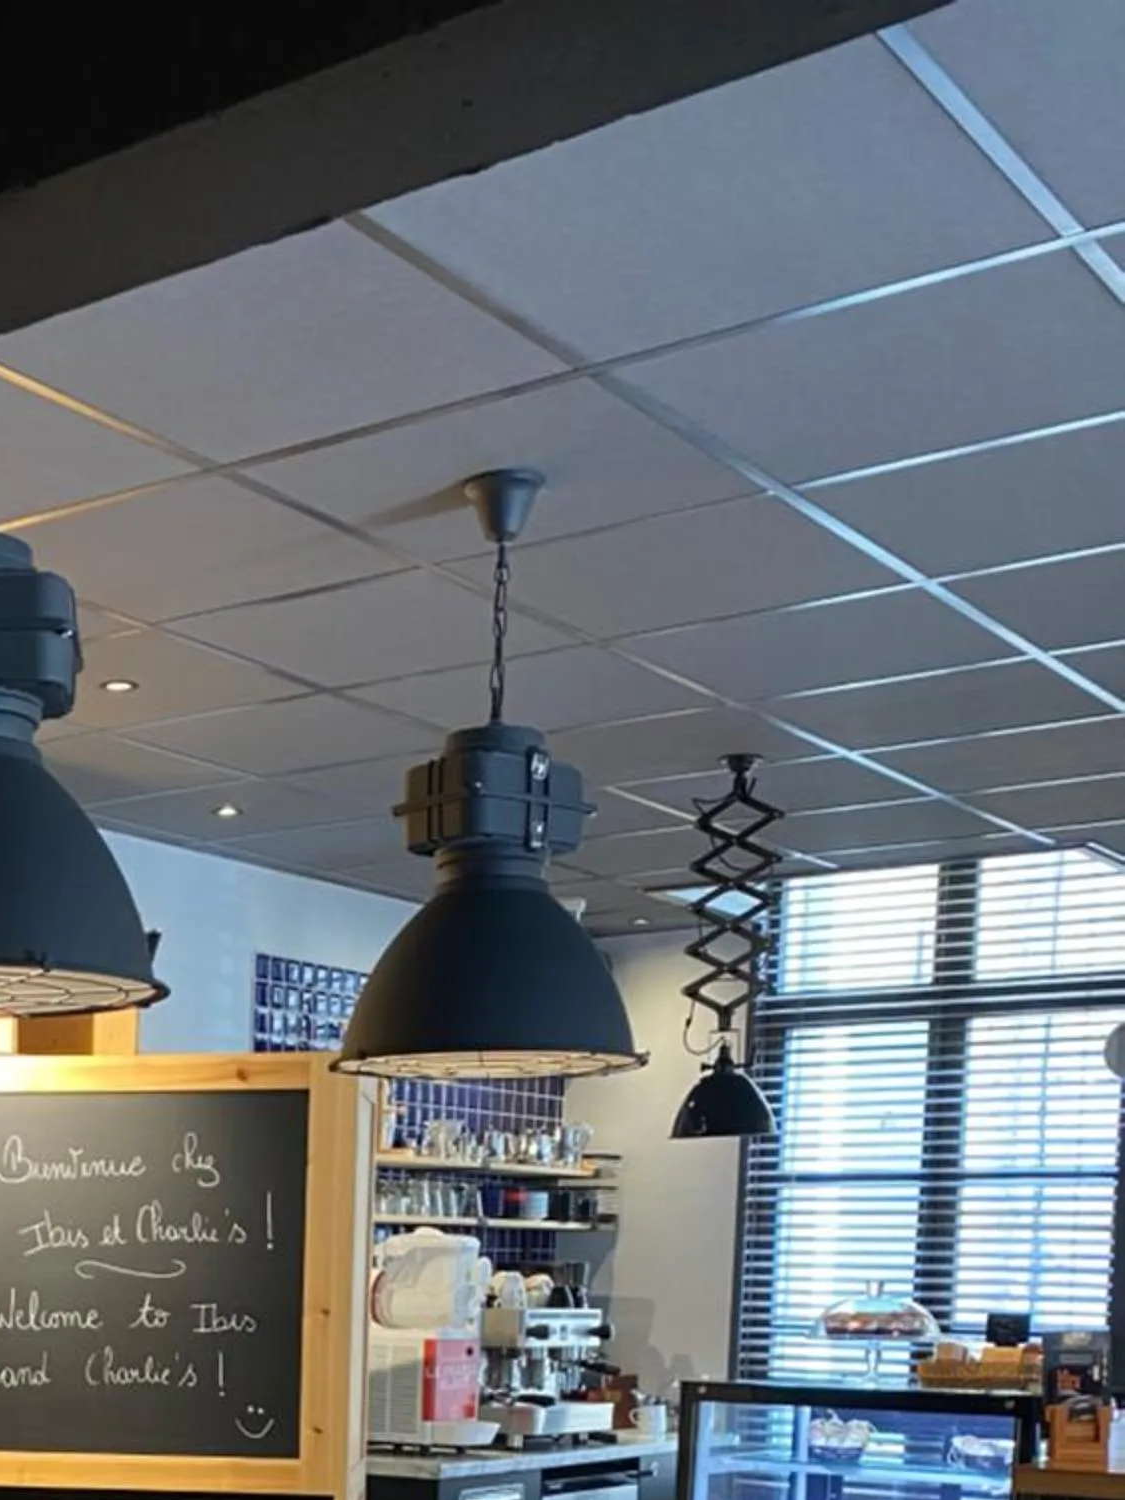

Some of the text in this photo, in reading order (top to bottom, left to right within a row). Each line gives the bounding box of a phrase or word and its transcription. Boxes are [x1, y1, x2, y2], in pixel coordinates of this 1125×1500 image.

[171, 1131, 221, 1188] chez
[17, 1207, 90, 1257] Ibis
[98, 1213, 128, 1246] et
[128, 1292, 172, 1330] to
[190, 1302, 258, 1334] Ibis
